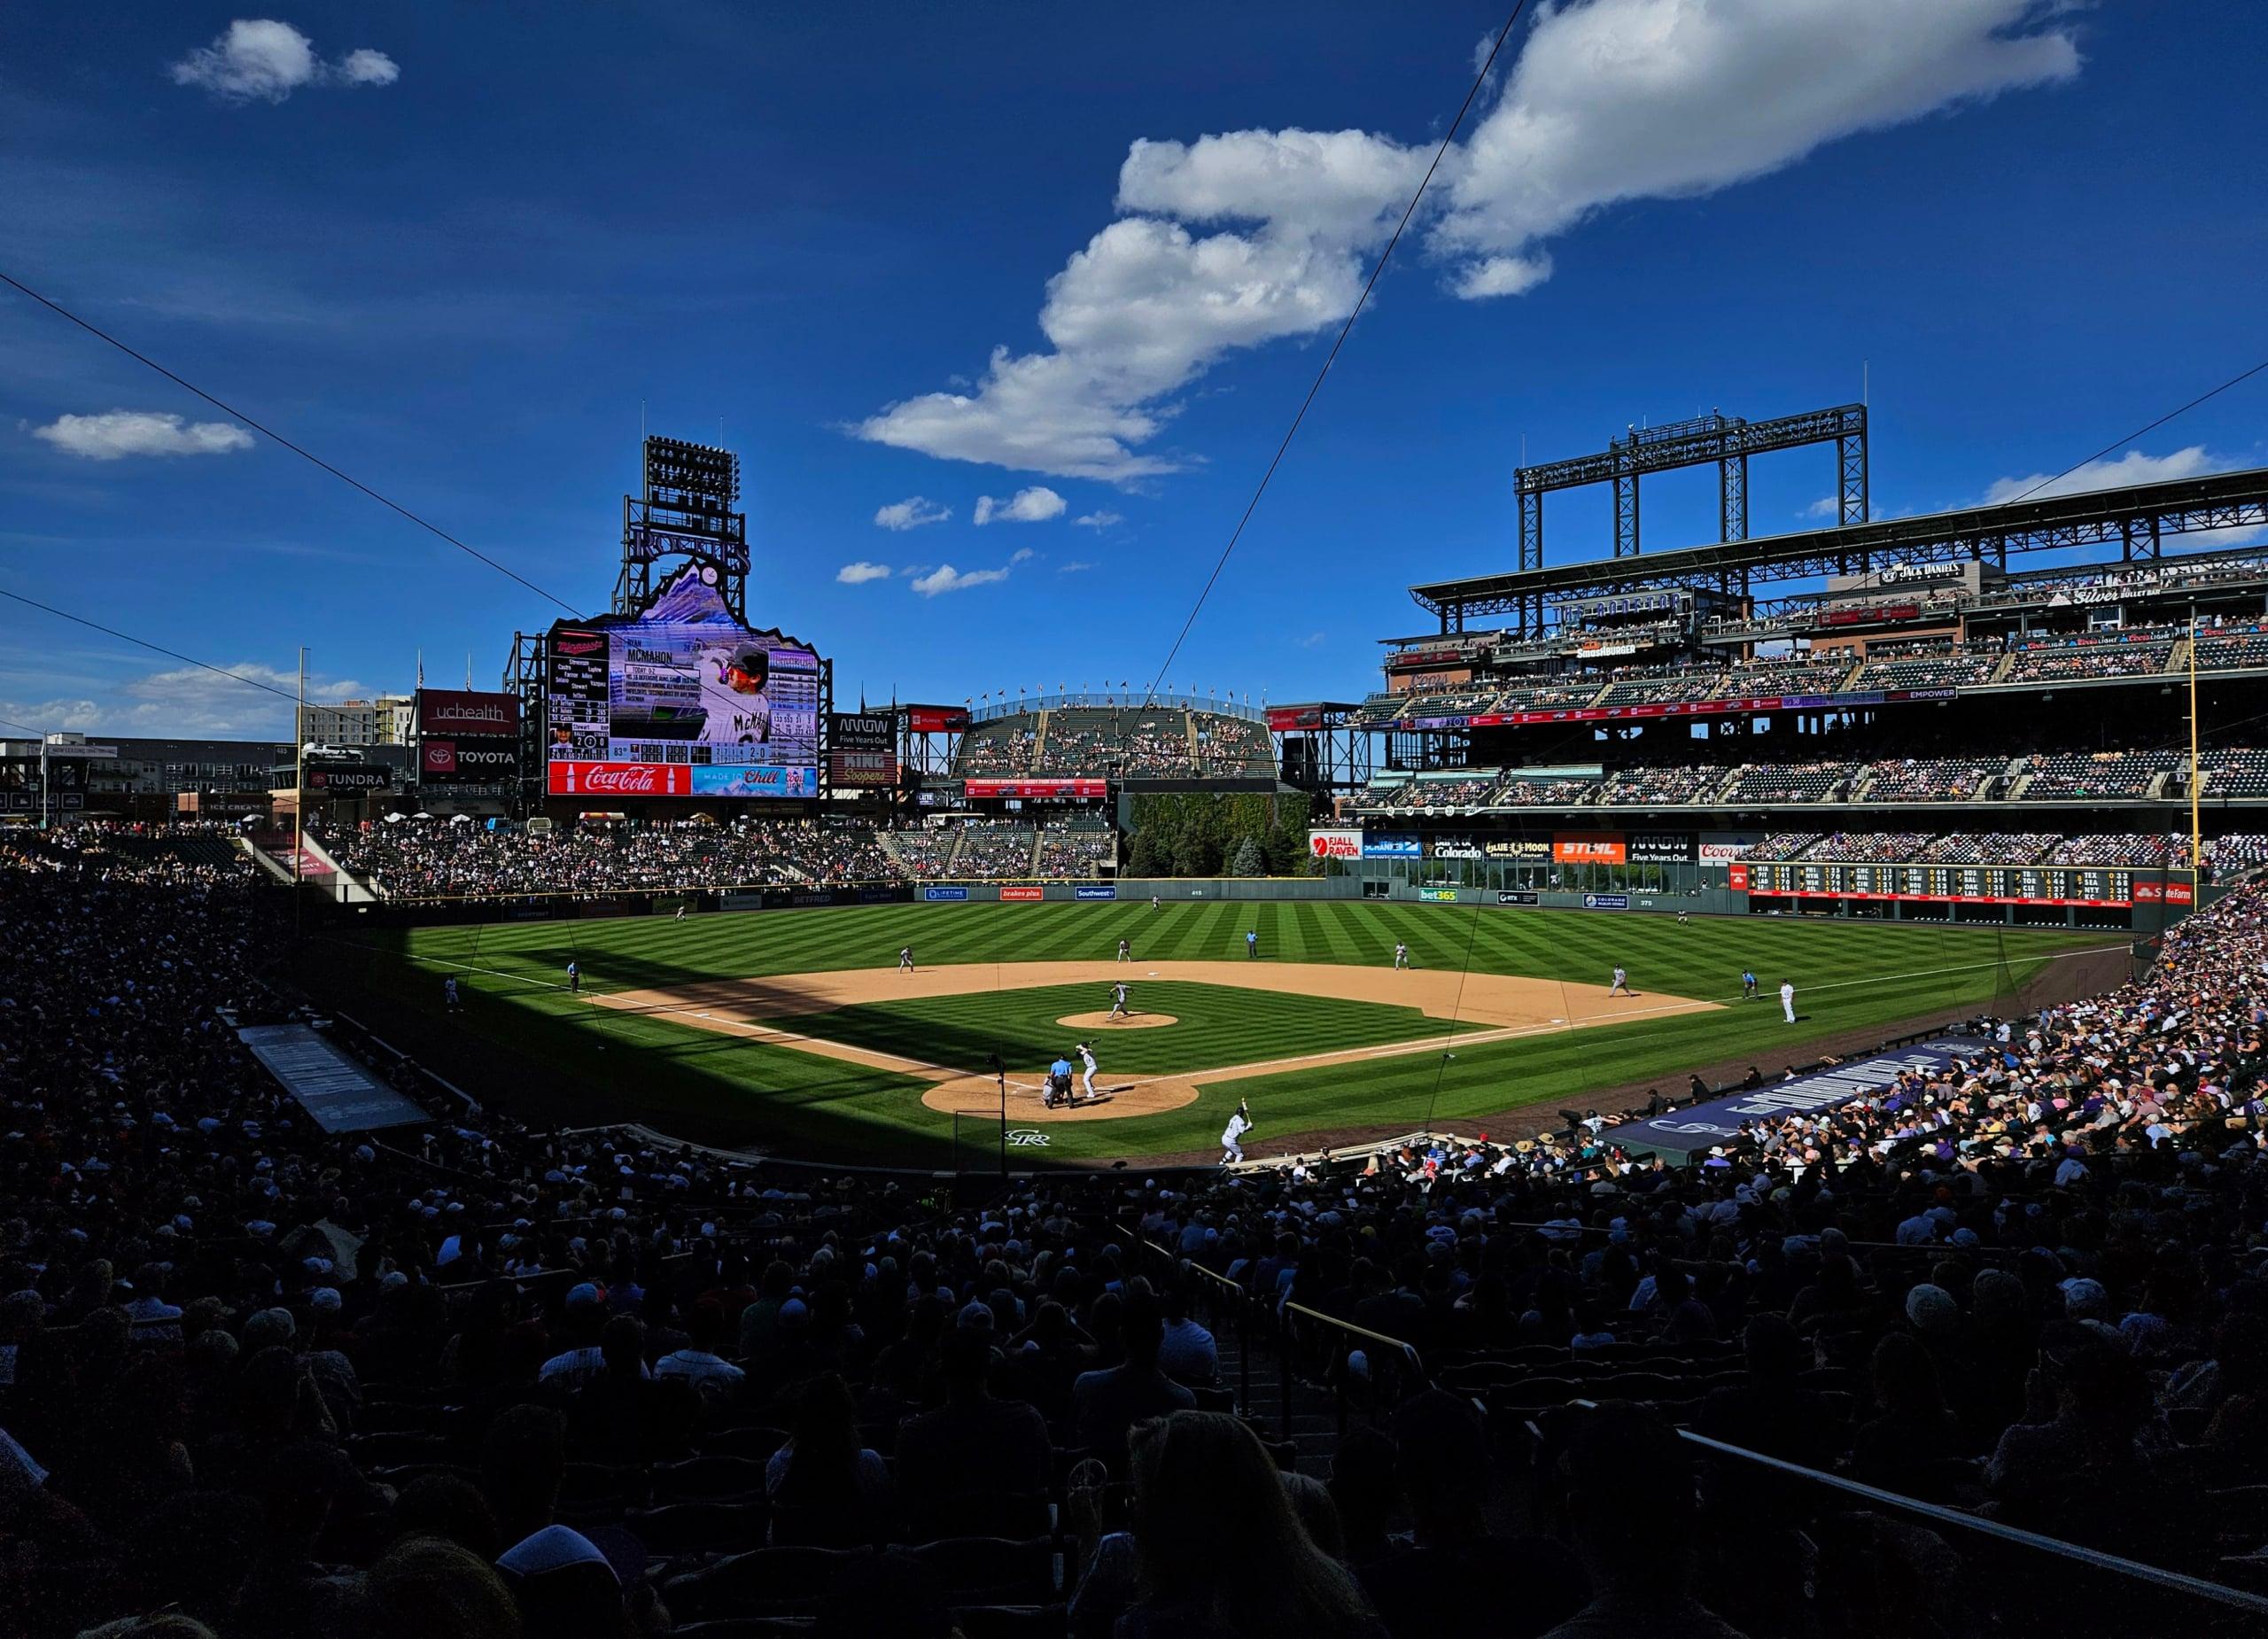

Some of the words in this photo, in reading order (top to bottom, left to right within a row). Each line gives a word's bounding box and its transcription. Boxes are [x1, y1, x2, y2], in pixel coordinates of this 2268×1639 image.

[633, 525, 751, 574] ROCKIES
[1899, 564, 1922, 578] JACK
[2073, 588, 2120, 604] Silver
[627, 649, 672, 664] MCMAHON
[1910, 688, 1955, 700] EMPOWER
[437, 703, 504, 722] uchealth
[840, 734, 854, 743] Five
[855, 735, 874, 744] Years
[874, 736, 888, 745] Out
[457, 751, 516, 764] TOYOTA
[614, 747, 627, 757] 83°
[750, 748, 765, 758] 2-0
[843, 755, 885, 768] KING
[326, 773, 385, 786] TUNDRA
[585, 765, 657, 791] Coca-Cola
[743, 769, 781, 784] Chill
[843, 767, 886, 783] Soopers
[1434, 835, 1459, 847] Bank
[1461, 835, 1472, 847] of
[1486, 842, 1509, 853] BLUE
[1524, 843, 1550, 852] MOON
[1434, 846, 1482, 858] Colorado
[1702, 843, 1743, 858] Coors
[1649, 853, 1673, 862] Years
[1673, 853, 1689, 862] Out
[1420, 889, 1456, 901] bet365
